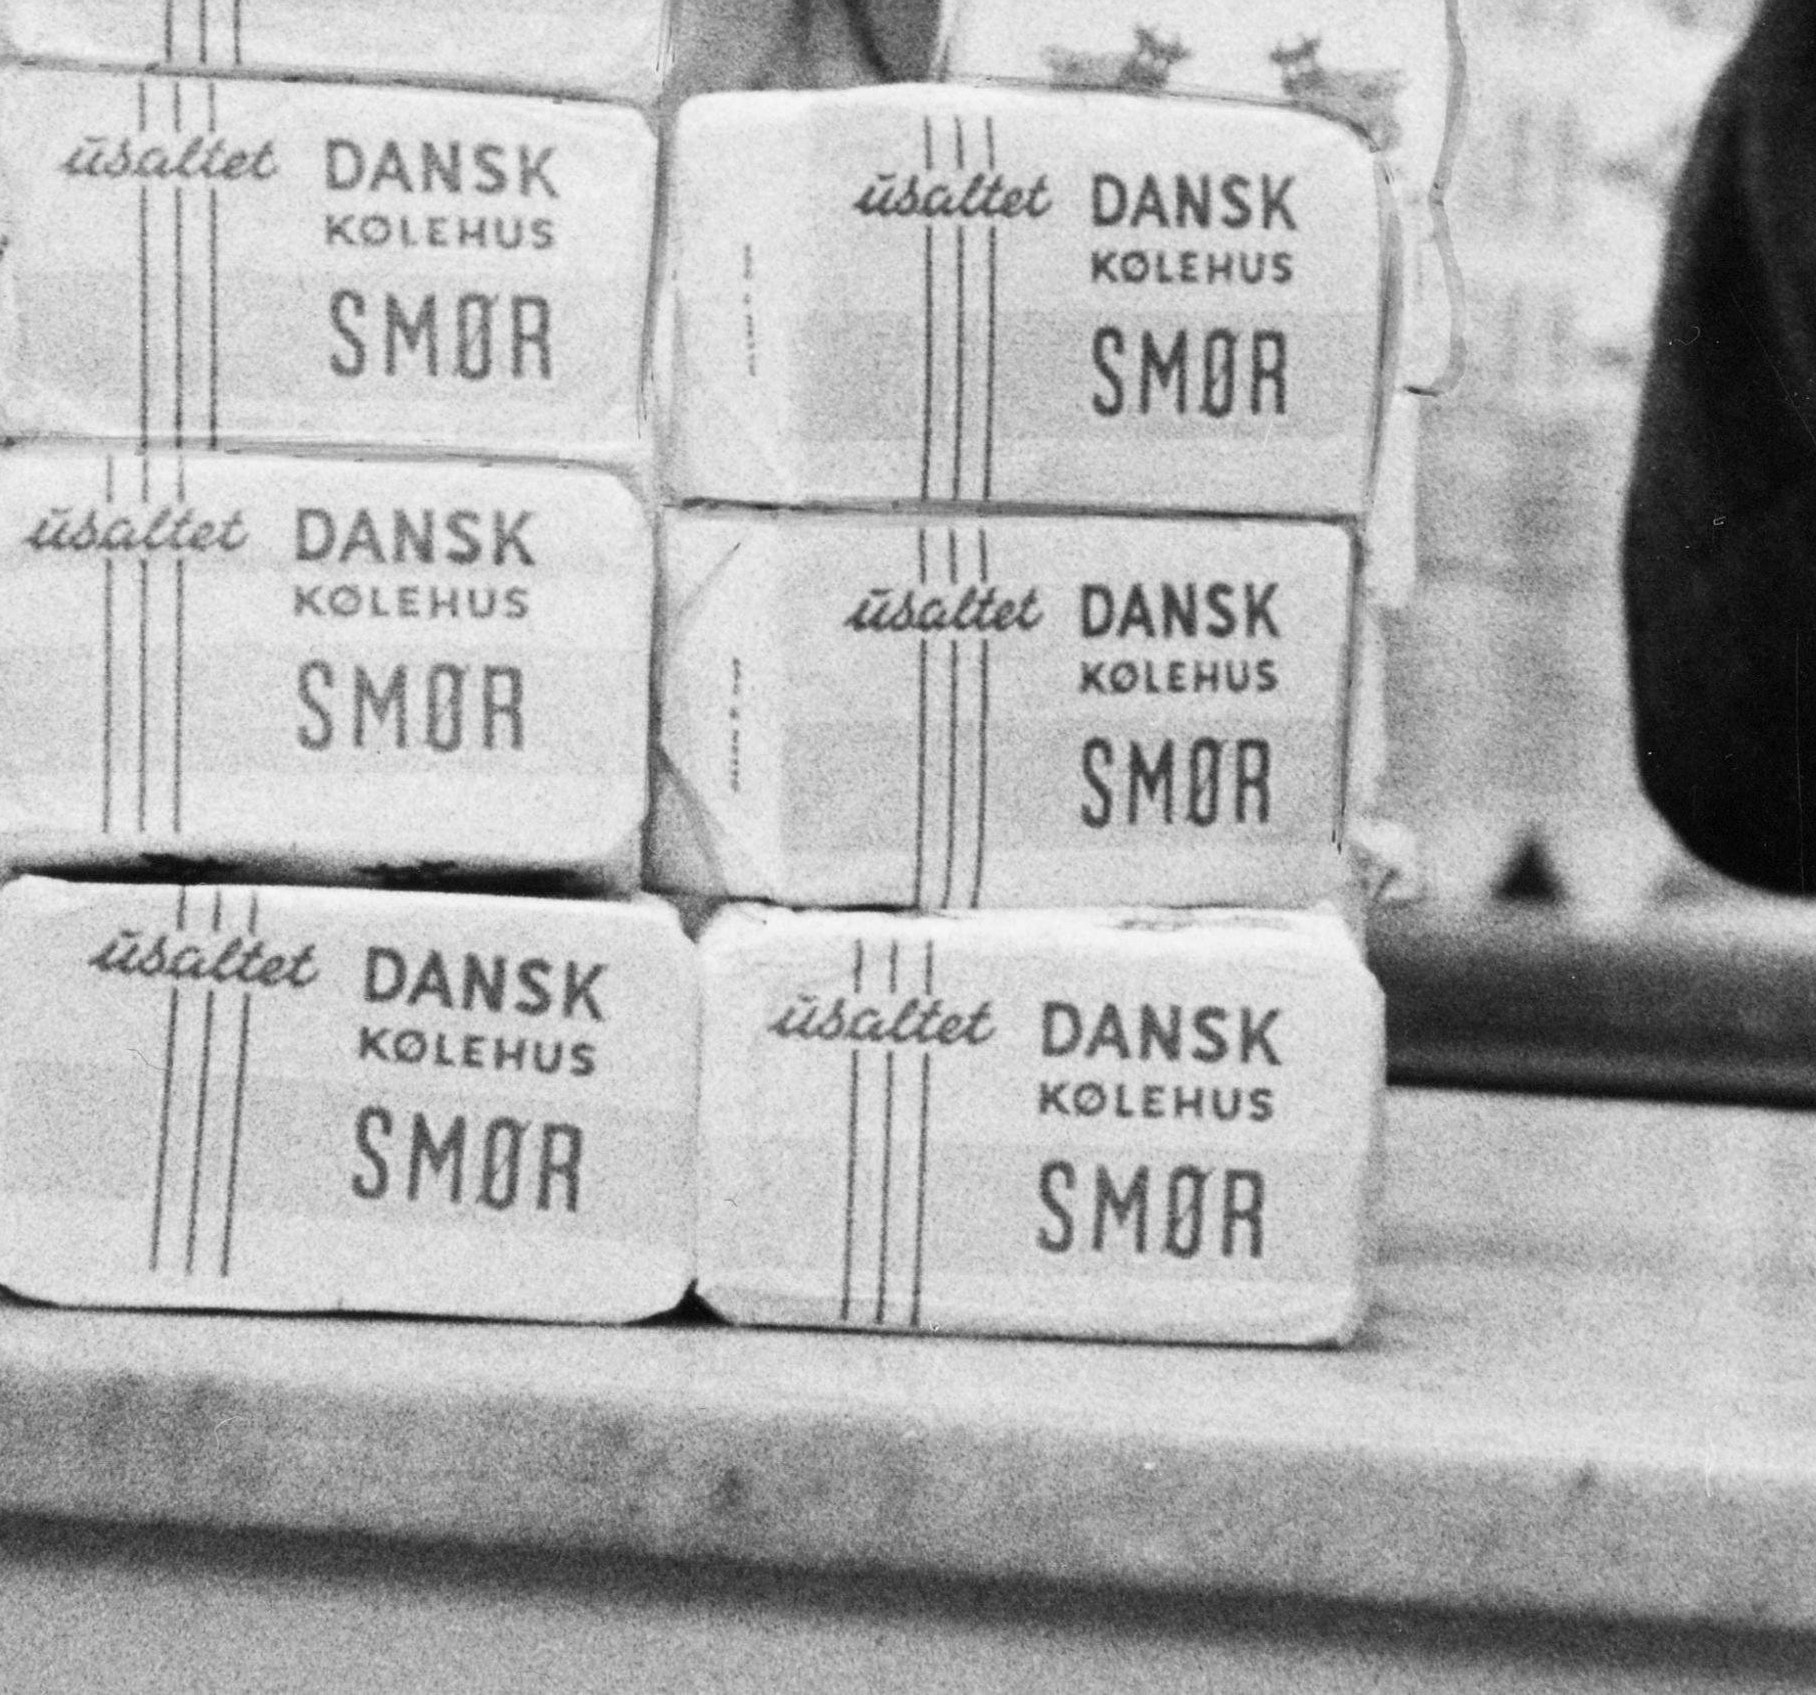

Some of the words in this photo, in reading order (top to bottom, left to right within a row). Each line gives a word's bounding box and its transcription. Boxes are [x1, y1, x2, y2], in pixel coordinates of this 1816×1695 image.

[324, 137, 558, 199] DANSK
[324, 213, 555, 251] KØLEHUS
[1091, 172, 1297, 231] DANSK
[1090, 249, 1293, 286] KØLEHUS
[328, 287, 552, 382] SMØR
[1091, 324, 1287, 419] SMØR
[294, 507, 536, 568] DANSK
[293, 584, 529, 620] KØLEHUS
[1080, 582, 1280, 639] DANSK
[297, 659, 524, 754] SMØR
[1079, 658, 1278, 695] KØLEHUS
[1081, 735, 1271, 829] SMØR
[363, 945, 606, 1022] DANSK
[357, 1025, 596, 1078] KØLEHUS
[1041, 1000, 1282, 1067] DANSK
[1038, 1080, 1274, 1123] KØLEHUS
[351, 1105, 583, 1213] SMØR
[1037, 1159, 1265, 1260] SMØR
